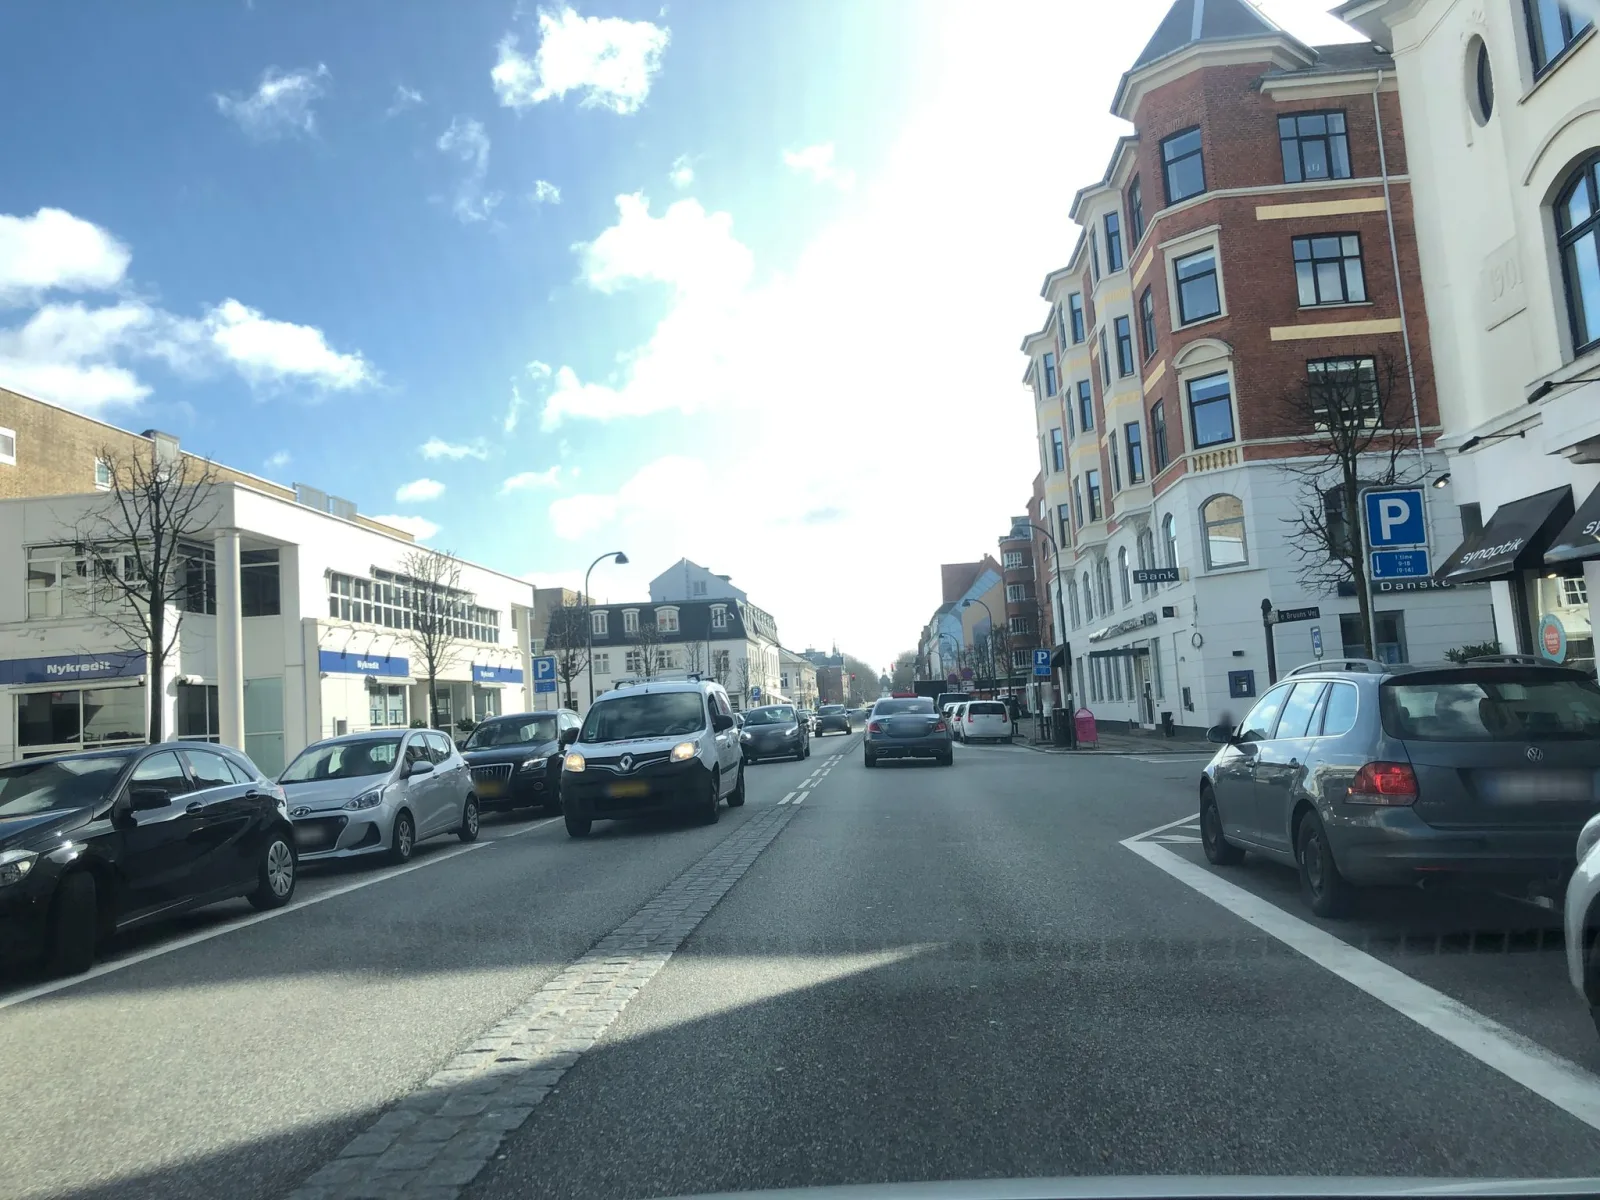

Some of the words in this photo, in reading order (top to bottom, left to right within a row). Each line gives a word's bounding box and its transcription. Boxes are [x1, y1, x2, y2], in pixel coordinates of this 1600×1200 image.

[1379, 498, 1410, 540] P
[1460, 538, 1524, 565] synoptik
[1138, 571, 1176, 581] Bank
[1380, 579, 1451, 592] Danske
[1036, 651, 1048, 664] P
[46, 660, 111, 676] Nykredit
[357, 660, 380, 670] Nykredit
[537, 660, 550, 679] P
